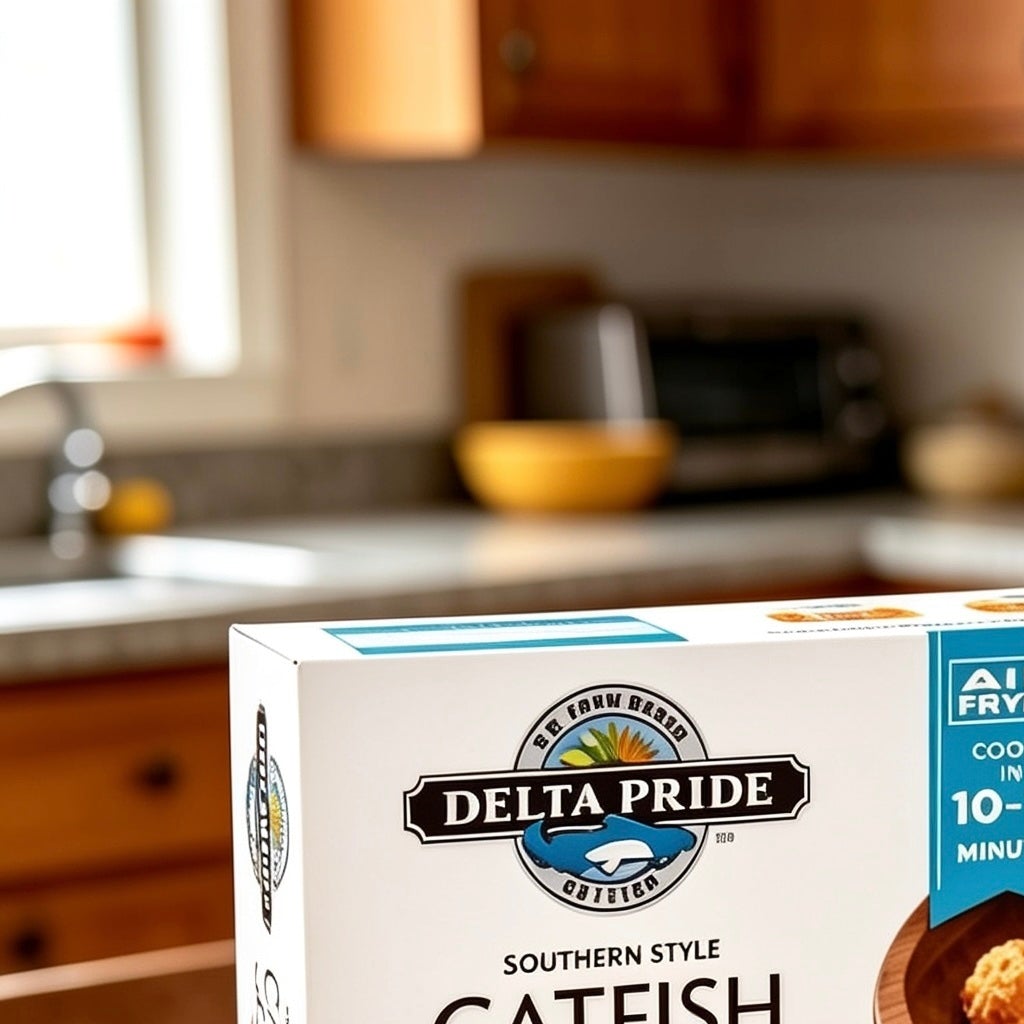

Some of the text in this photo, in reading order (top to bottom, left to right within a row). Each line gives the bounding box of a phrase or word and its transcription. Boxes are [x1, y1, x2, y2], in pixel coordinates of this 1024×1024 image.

[1000, 764, 1023, 782] IN
[443, 771, 774, 827] DELTA PRIDE
[503, 938, 720, 976] SOUTHERN STYLE
